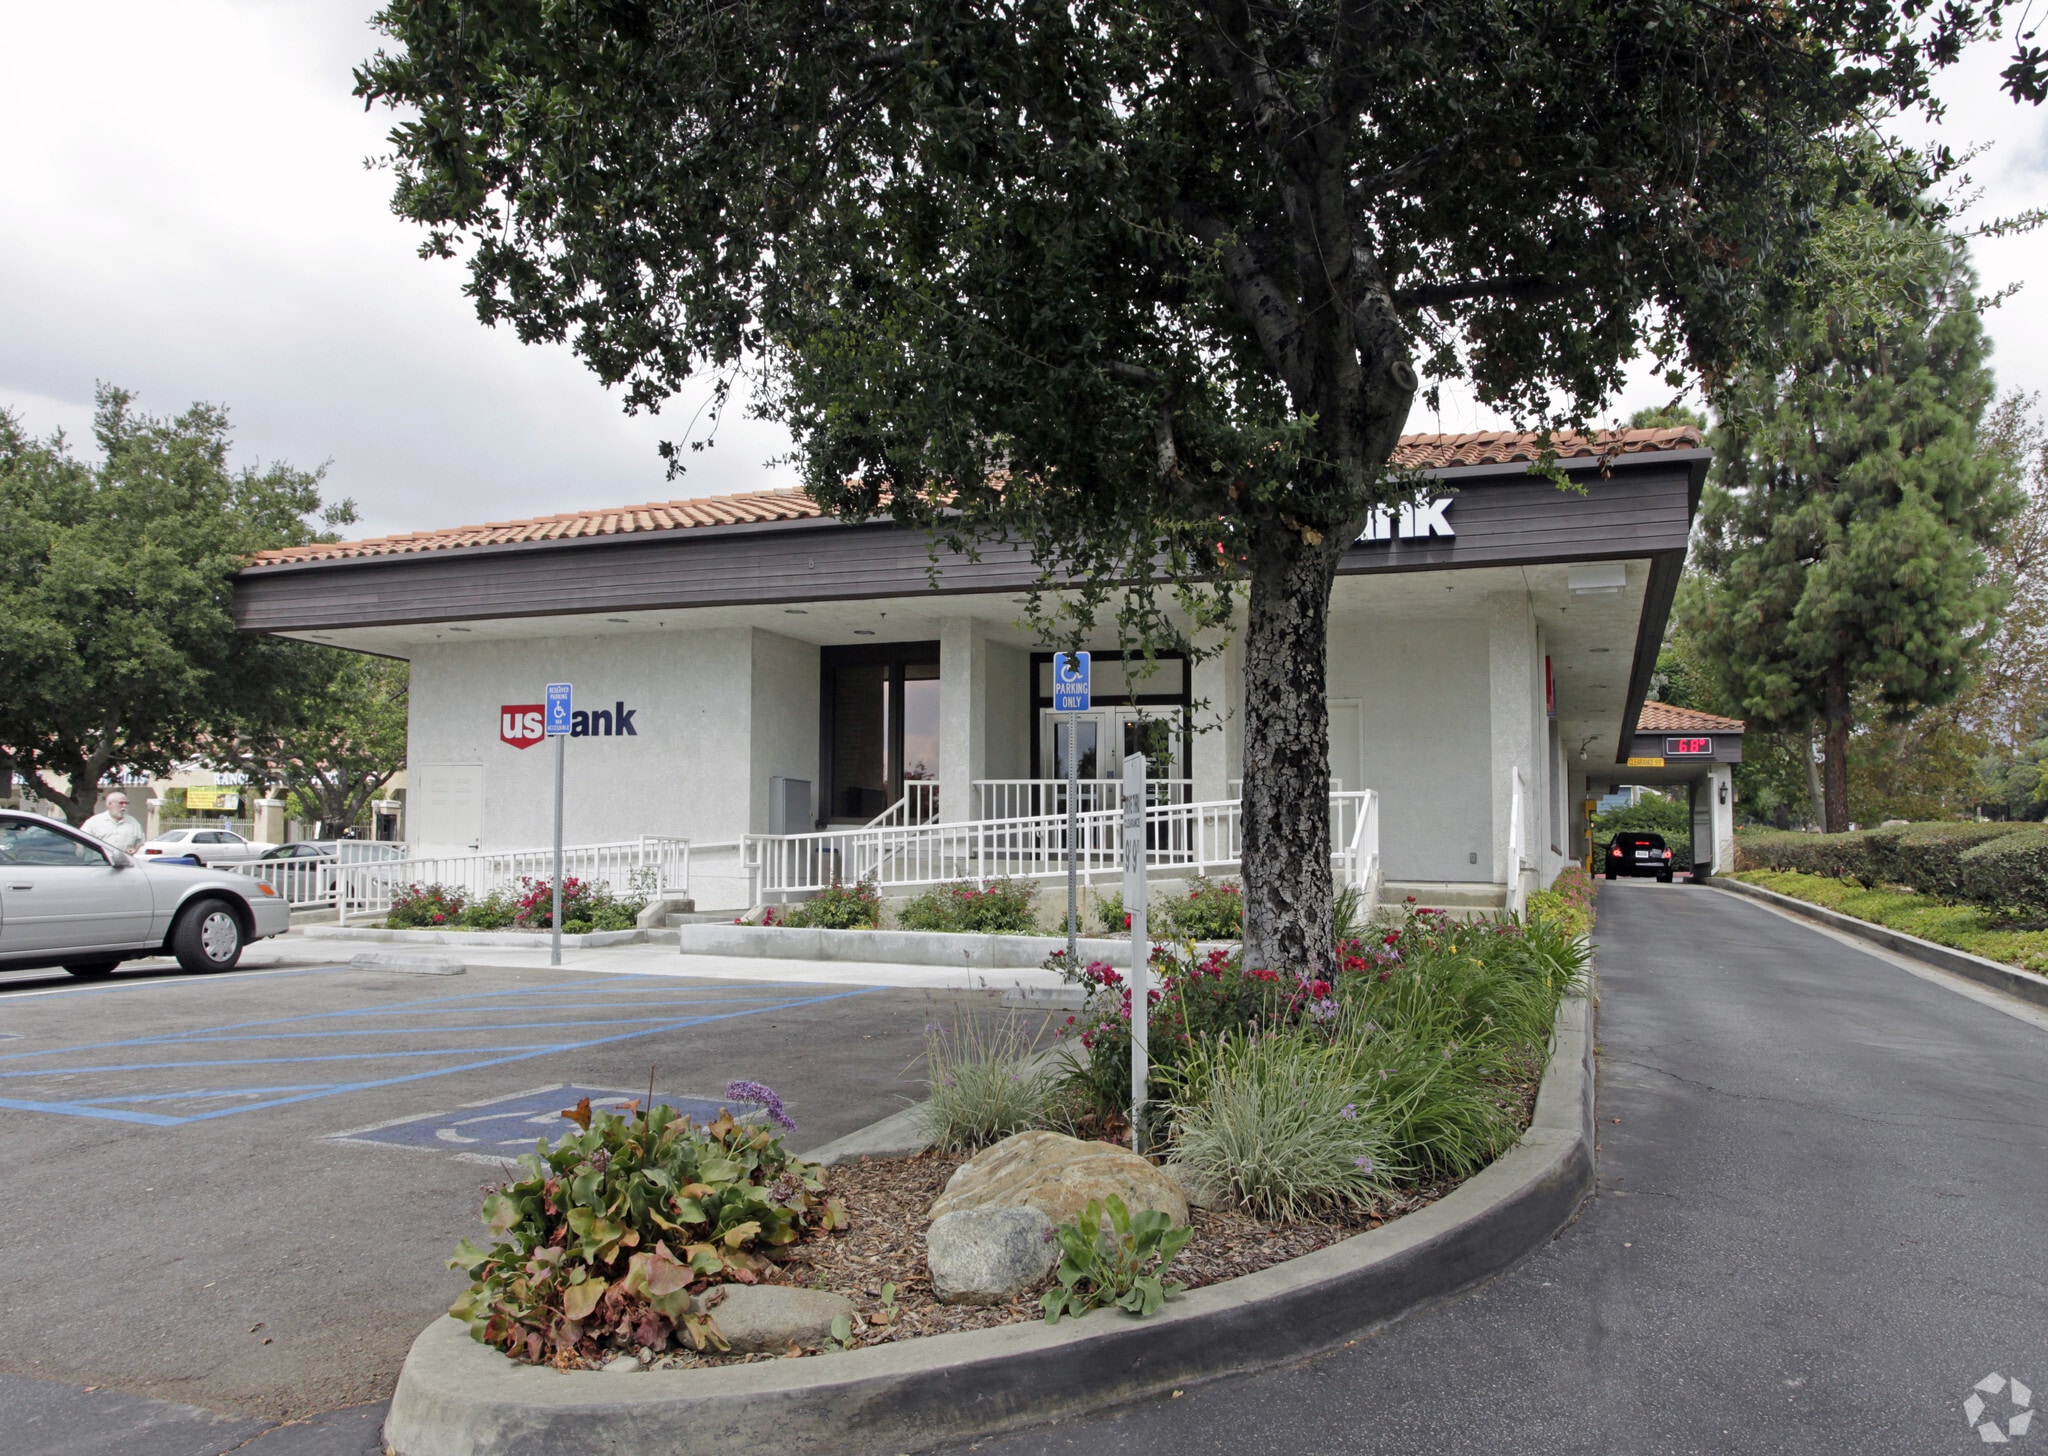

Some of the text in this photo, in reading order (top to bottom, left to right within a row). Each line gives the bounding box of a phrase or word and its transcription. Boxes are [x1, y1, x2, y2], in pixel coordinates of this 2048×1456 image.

[1355, 487, 1455, 541] nk
[1056, 683, 1088, 695] PARKING
[1062, 696, 1082, 708] ONLY
[502, 701, 638, 739] us ank
